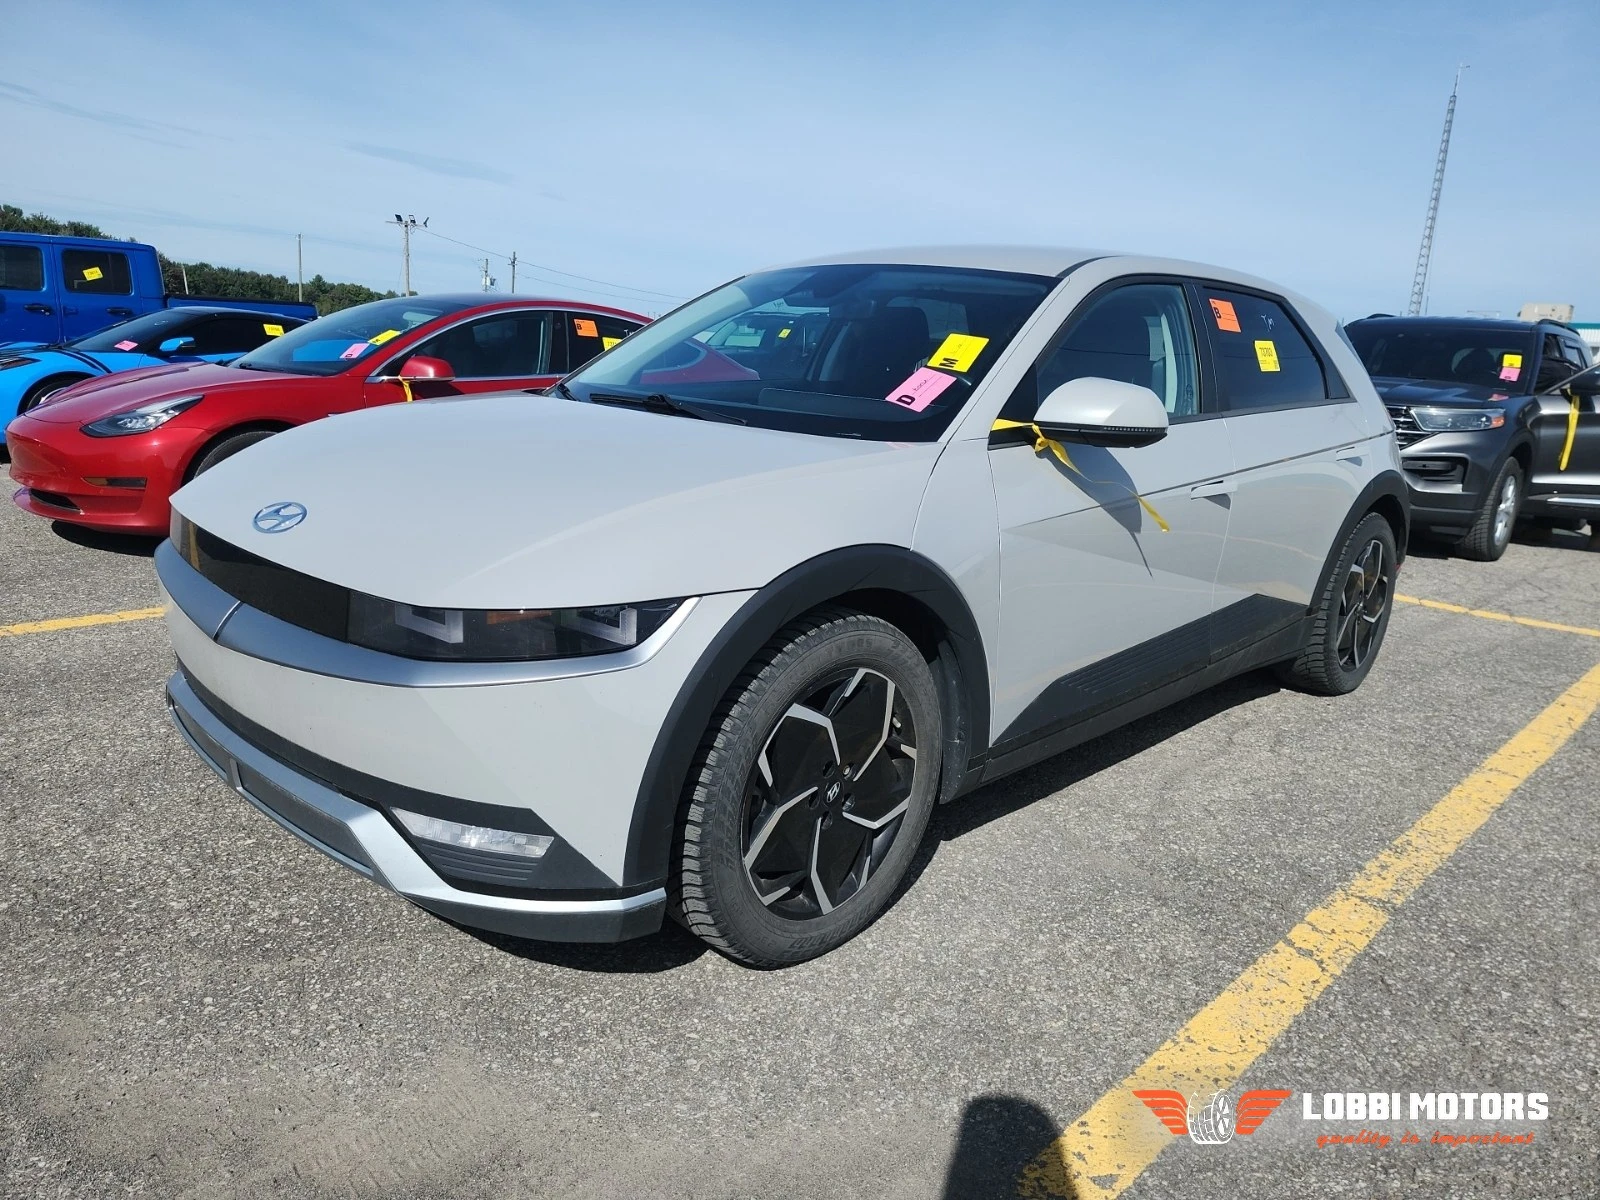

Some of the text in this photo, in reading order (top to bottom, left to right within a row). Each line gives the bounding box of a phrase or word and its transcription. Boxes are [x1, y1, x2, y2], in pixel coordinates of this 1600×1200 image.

[1213, 307, 1222, 319] B
[576, 323, 583, 331] B
[938, 357, 959, 368] M
[895, 394, 916, 406] D
